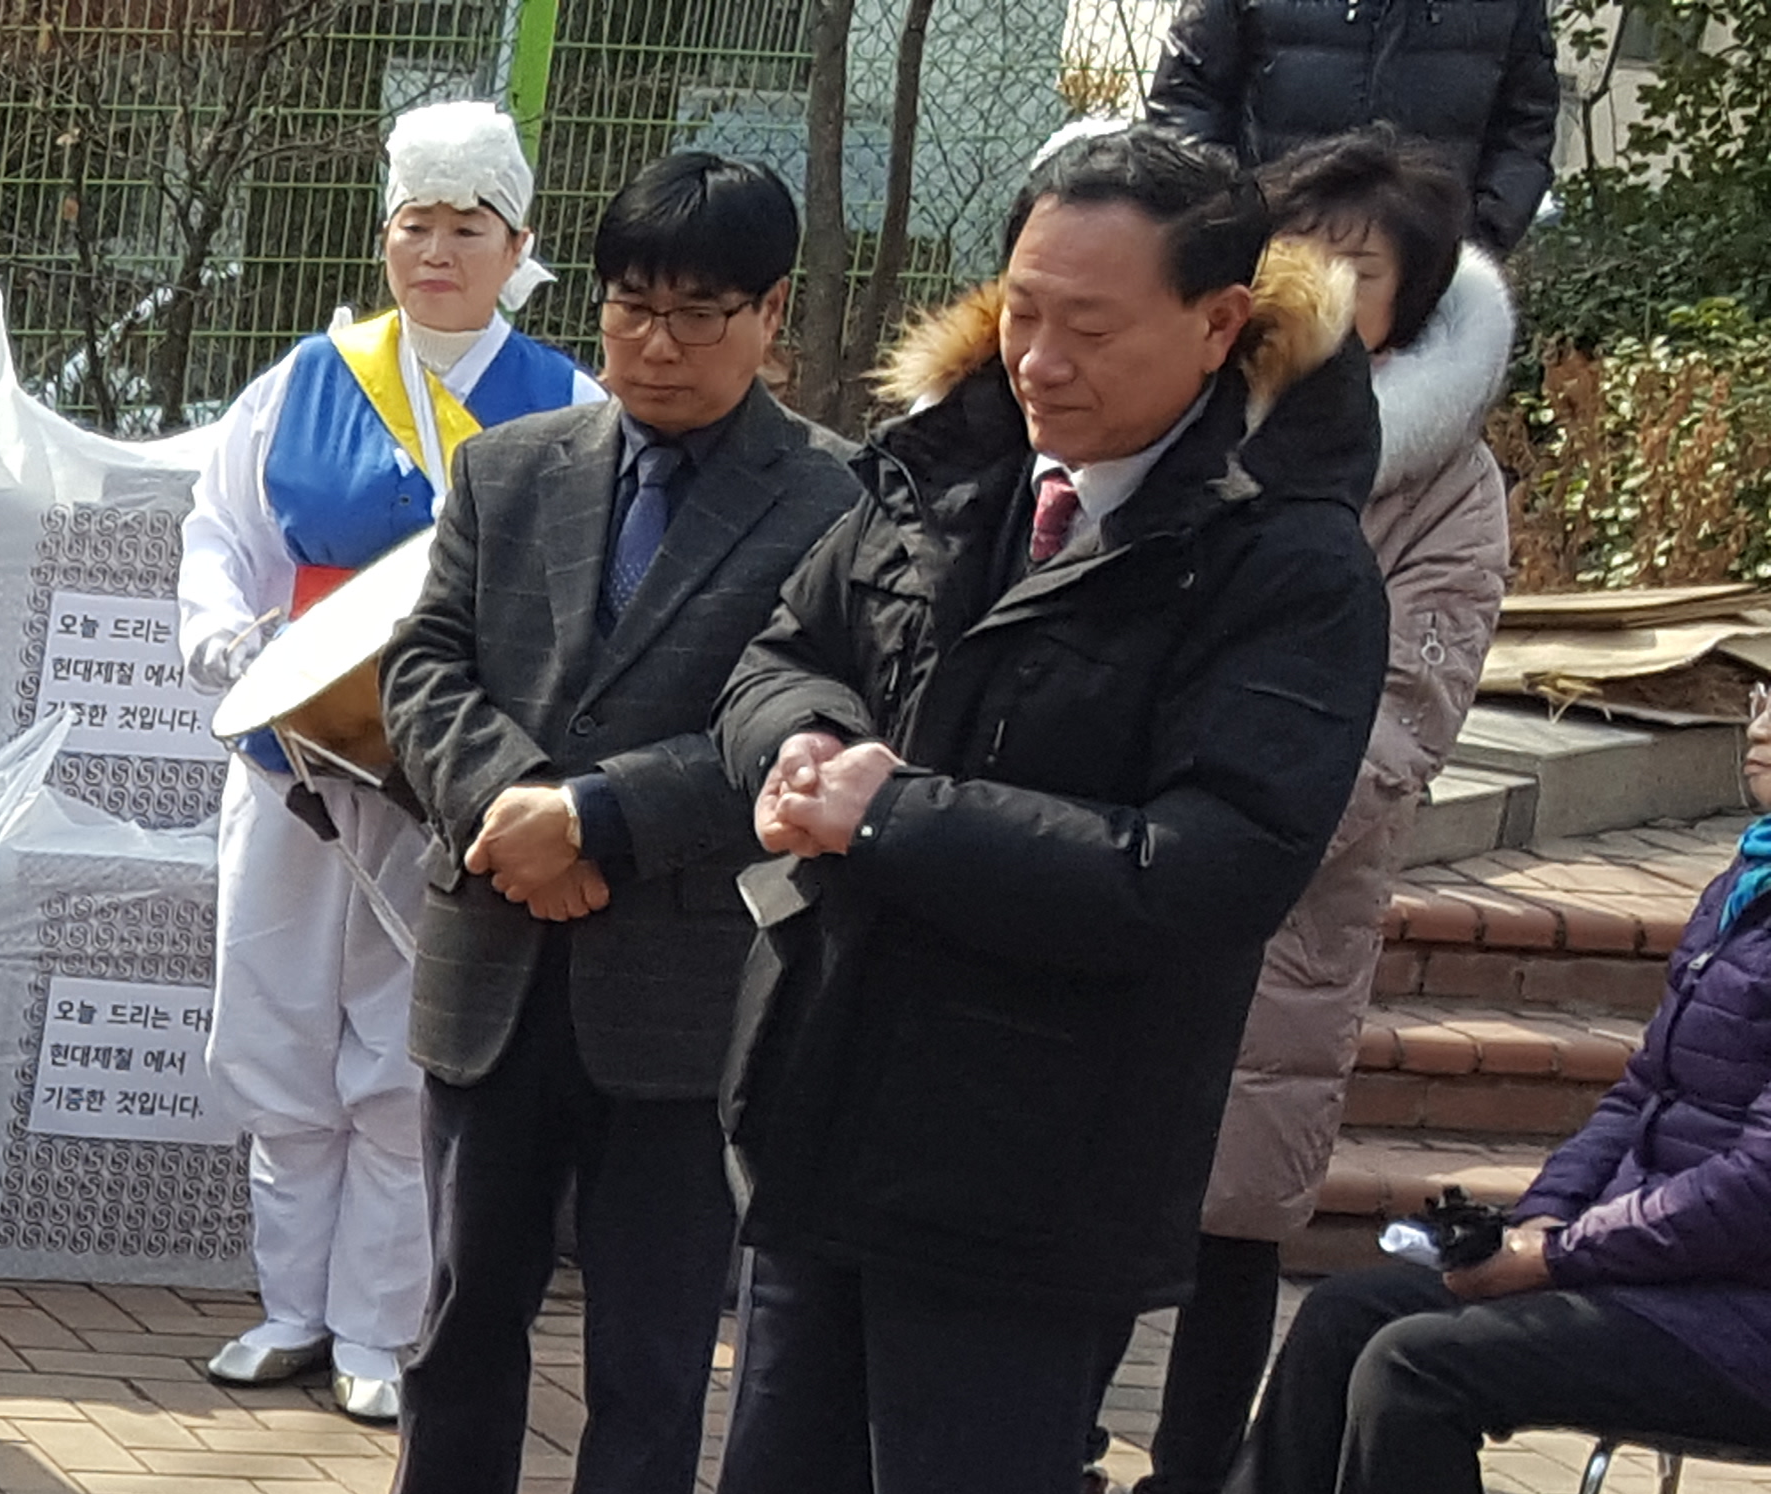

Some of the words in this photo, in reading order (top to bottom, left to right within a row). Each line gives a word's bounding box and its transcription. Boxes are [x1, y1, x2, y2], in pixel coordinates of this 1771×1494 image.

[57, 614, 99, 639] 오늘
[108, 618, 172, 643] 드리는
[145, 664, 184, 689] 에서
[118, 705, 202, 734] 것입니다.
[54, 1000, 97, 1025] 오늘
[106, 1004, 172, 1030] 드리는
[182, 1008, 213, 1033] 타
[143, 1050, 186, 1076] 에서
[42, 1087, 105, 1113] 기증한
[117, 1090, 204, 1119] 것입니다.
